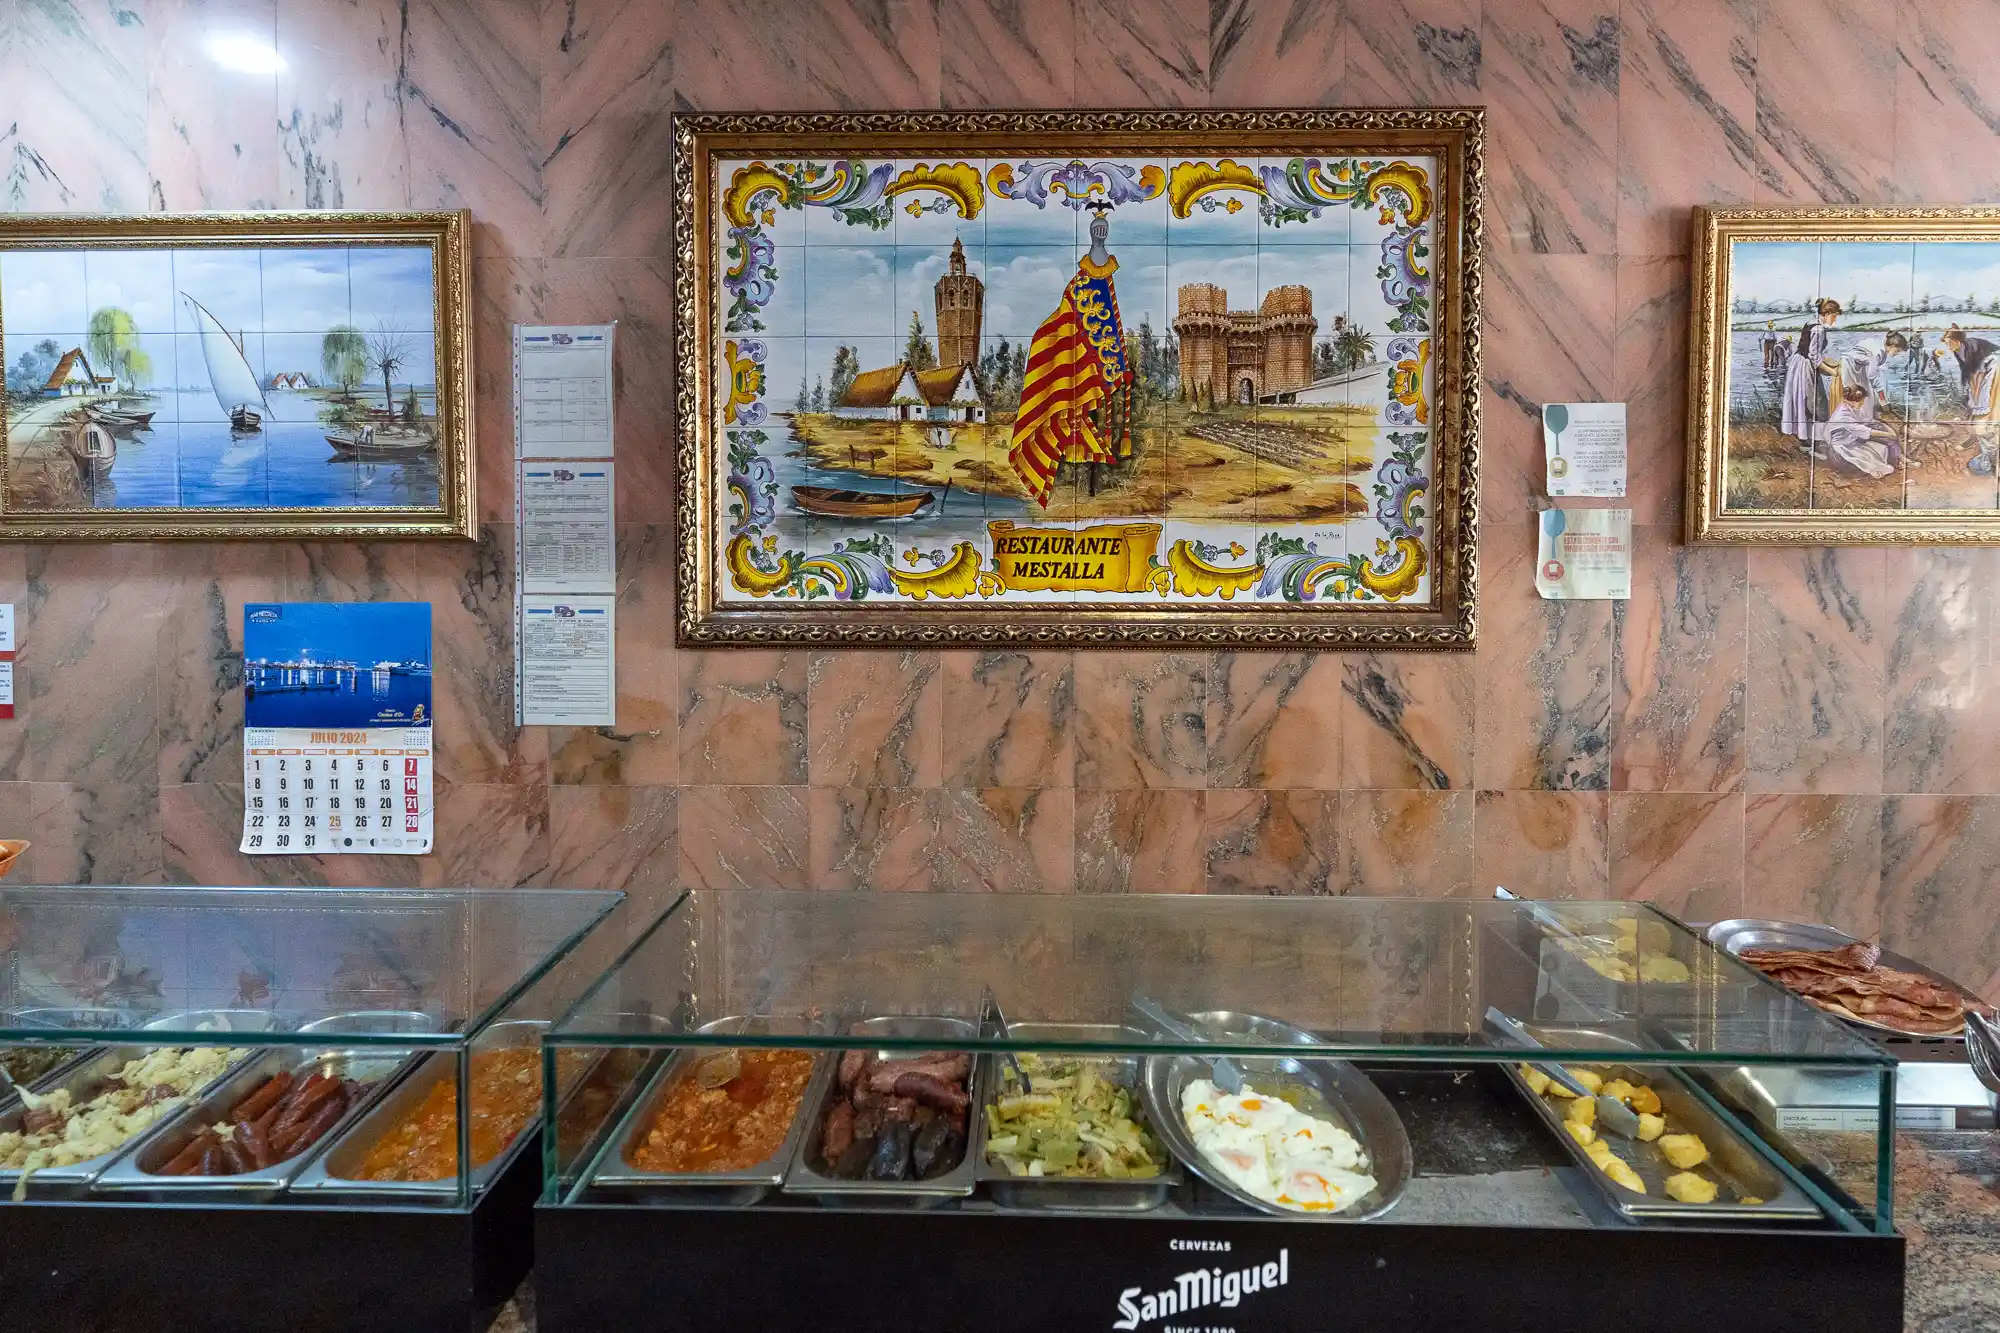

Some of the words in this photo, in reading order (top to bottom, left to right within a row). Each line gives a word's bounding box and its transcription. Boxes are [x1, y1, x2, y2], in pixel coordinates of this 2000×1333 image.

[996, 536, 1122, 555] RESTAURANTE
[1012, 562, 1105, 579] MESTALLA
[310, 732, 338, 744] JULIO
[340, 732, 367, 744] 2024
[254, 760, 260, 770] 1
[280, 760, 286, 770] 2
[306, 760, 312, 770] 3
[332, 760, 338, 770] 4
[358, 760, 364, 770] 5
[382, 760, 388, 772] 6
[408, 760, 414, 772] 7
[254, 778, 260, 790] 8
[280, 778, 286, 790] 9
[304, 778, 314, 790] 10
[330, 778, 338, 790] 11
[354, 778, 364, 790] 12
[380, 778, 390, 790] 13
[406, 778, 416, 790] 14
[252, 796, 264, 808] 15
[278, 796, 288, 808] 16
[304, 796, 314, 808] 17
[330, 796, 340, 808] 18
[354, 798, 366, 808] 19
[380, 798, 392, 808] 20
[406, 796, 417, 808] 21
[252, 816, 264, 828] 22
[278, 816, 290, 826] 23
[304, 816, 316, 826] 24
[330, 816, 341, 827] 25
[356, 816, 368, 828] 26
[382, 816, 392, 828] 27
[406, 815, 417, 827] 28
[250, 836, 262, 846] 29
[276, 834, 290, 846] 30
[304, 834, 314, 846] 31
[1169, 1239, 1231, 1251] CERVEZAS
